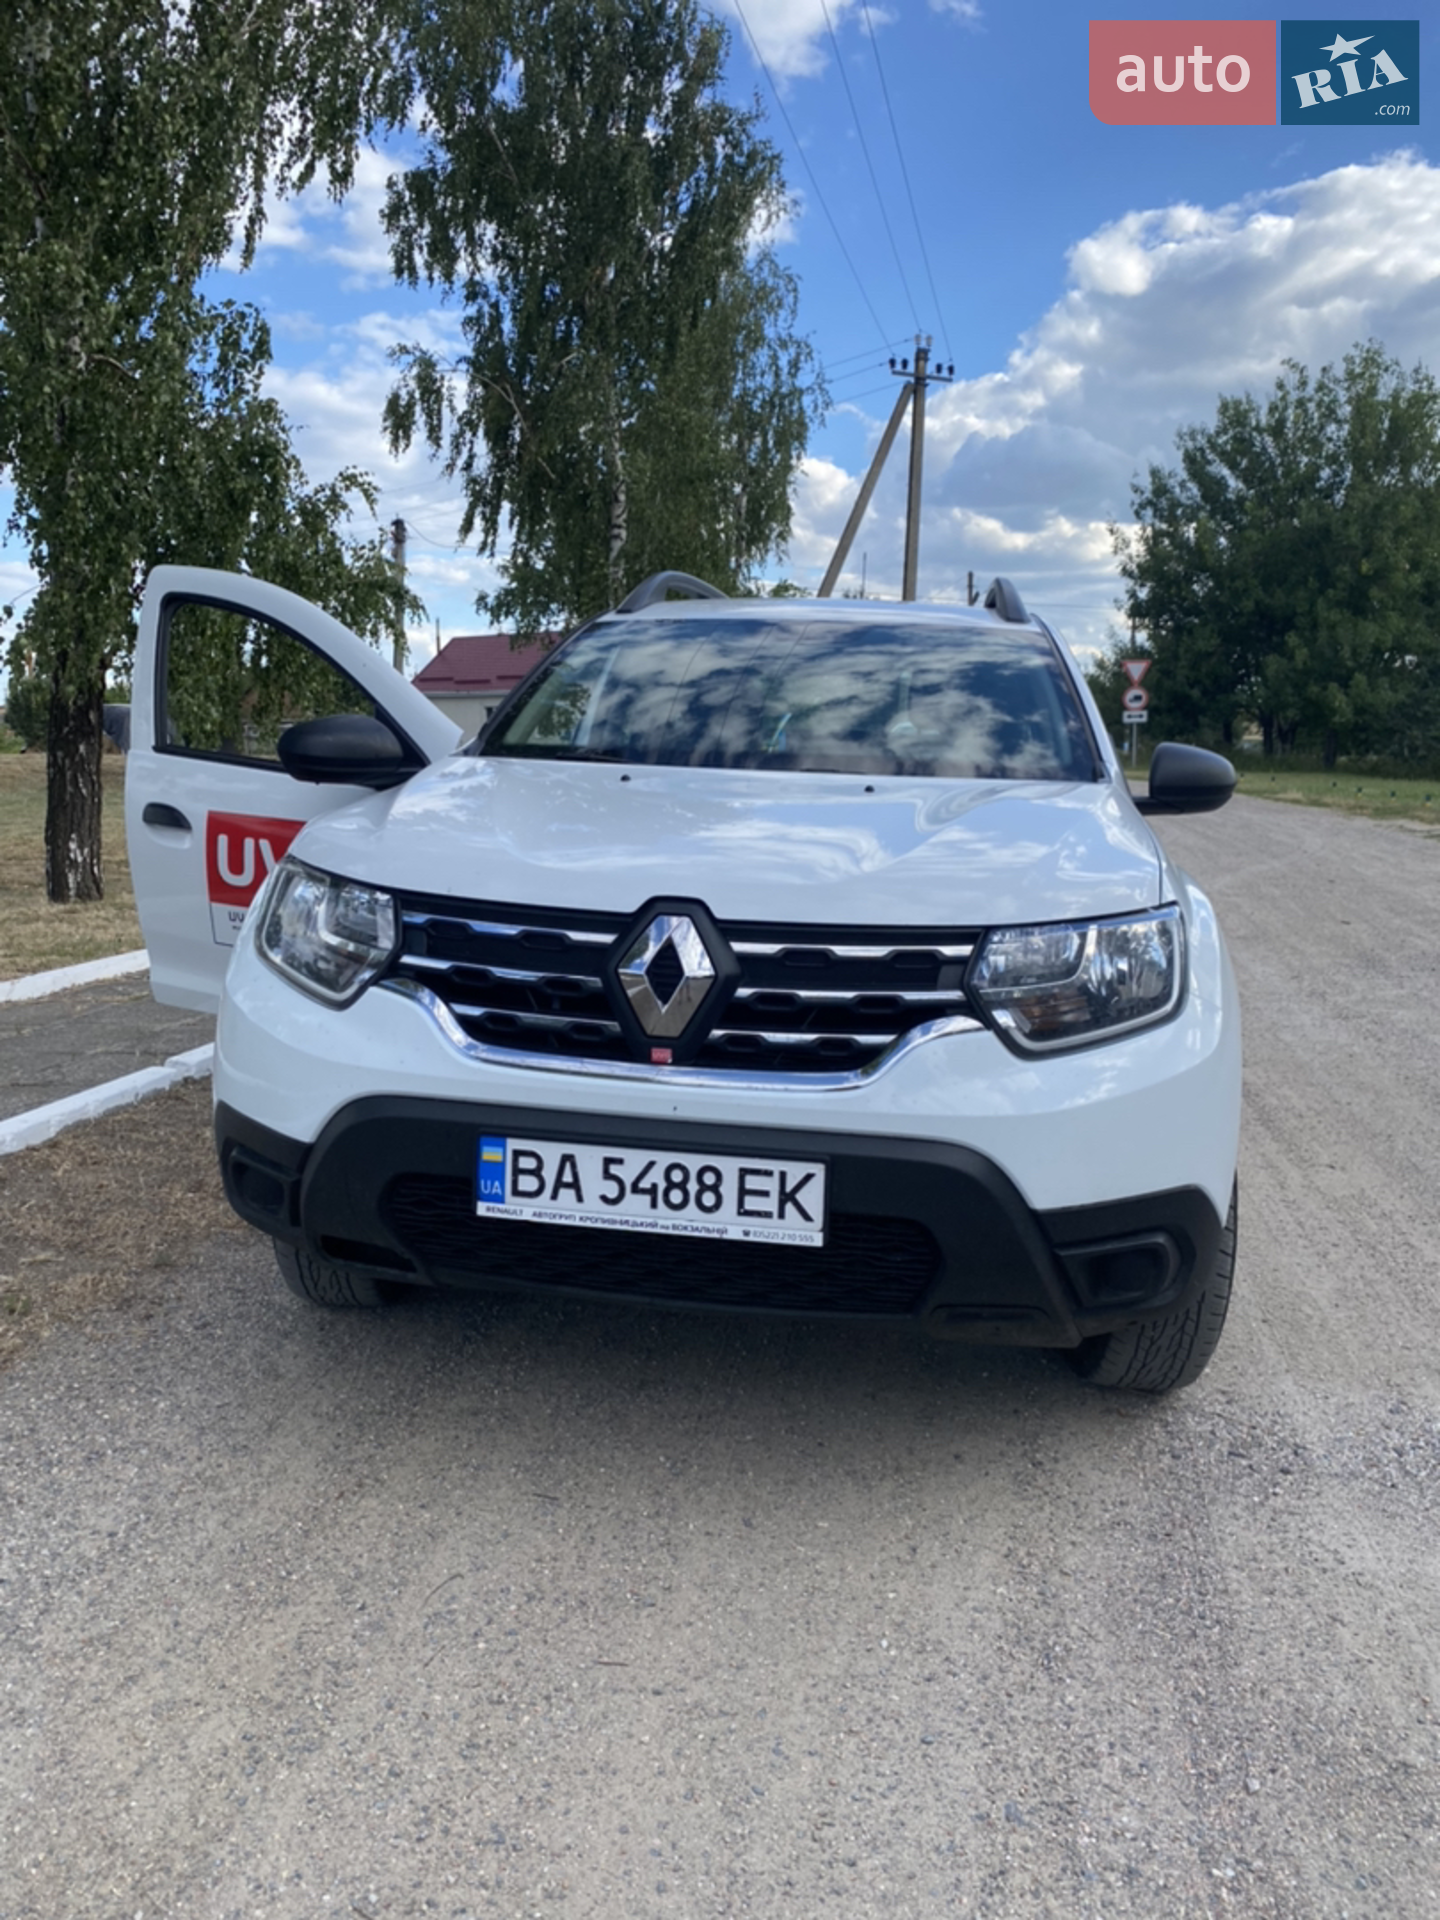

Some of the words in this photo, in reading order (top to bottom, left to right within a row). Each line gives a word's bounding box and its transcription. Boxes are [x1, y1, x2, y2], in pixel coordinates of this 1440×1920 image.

[480, 1178, 502, 1196] UA
[510, 1148, 584, 1204] BA
[598, 1156, 724, 1214] 5488
[737, 1167, 816, 1223] EK
[485, 1205, 523, 1217] RENAULT
